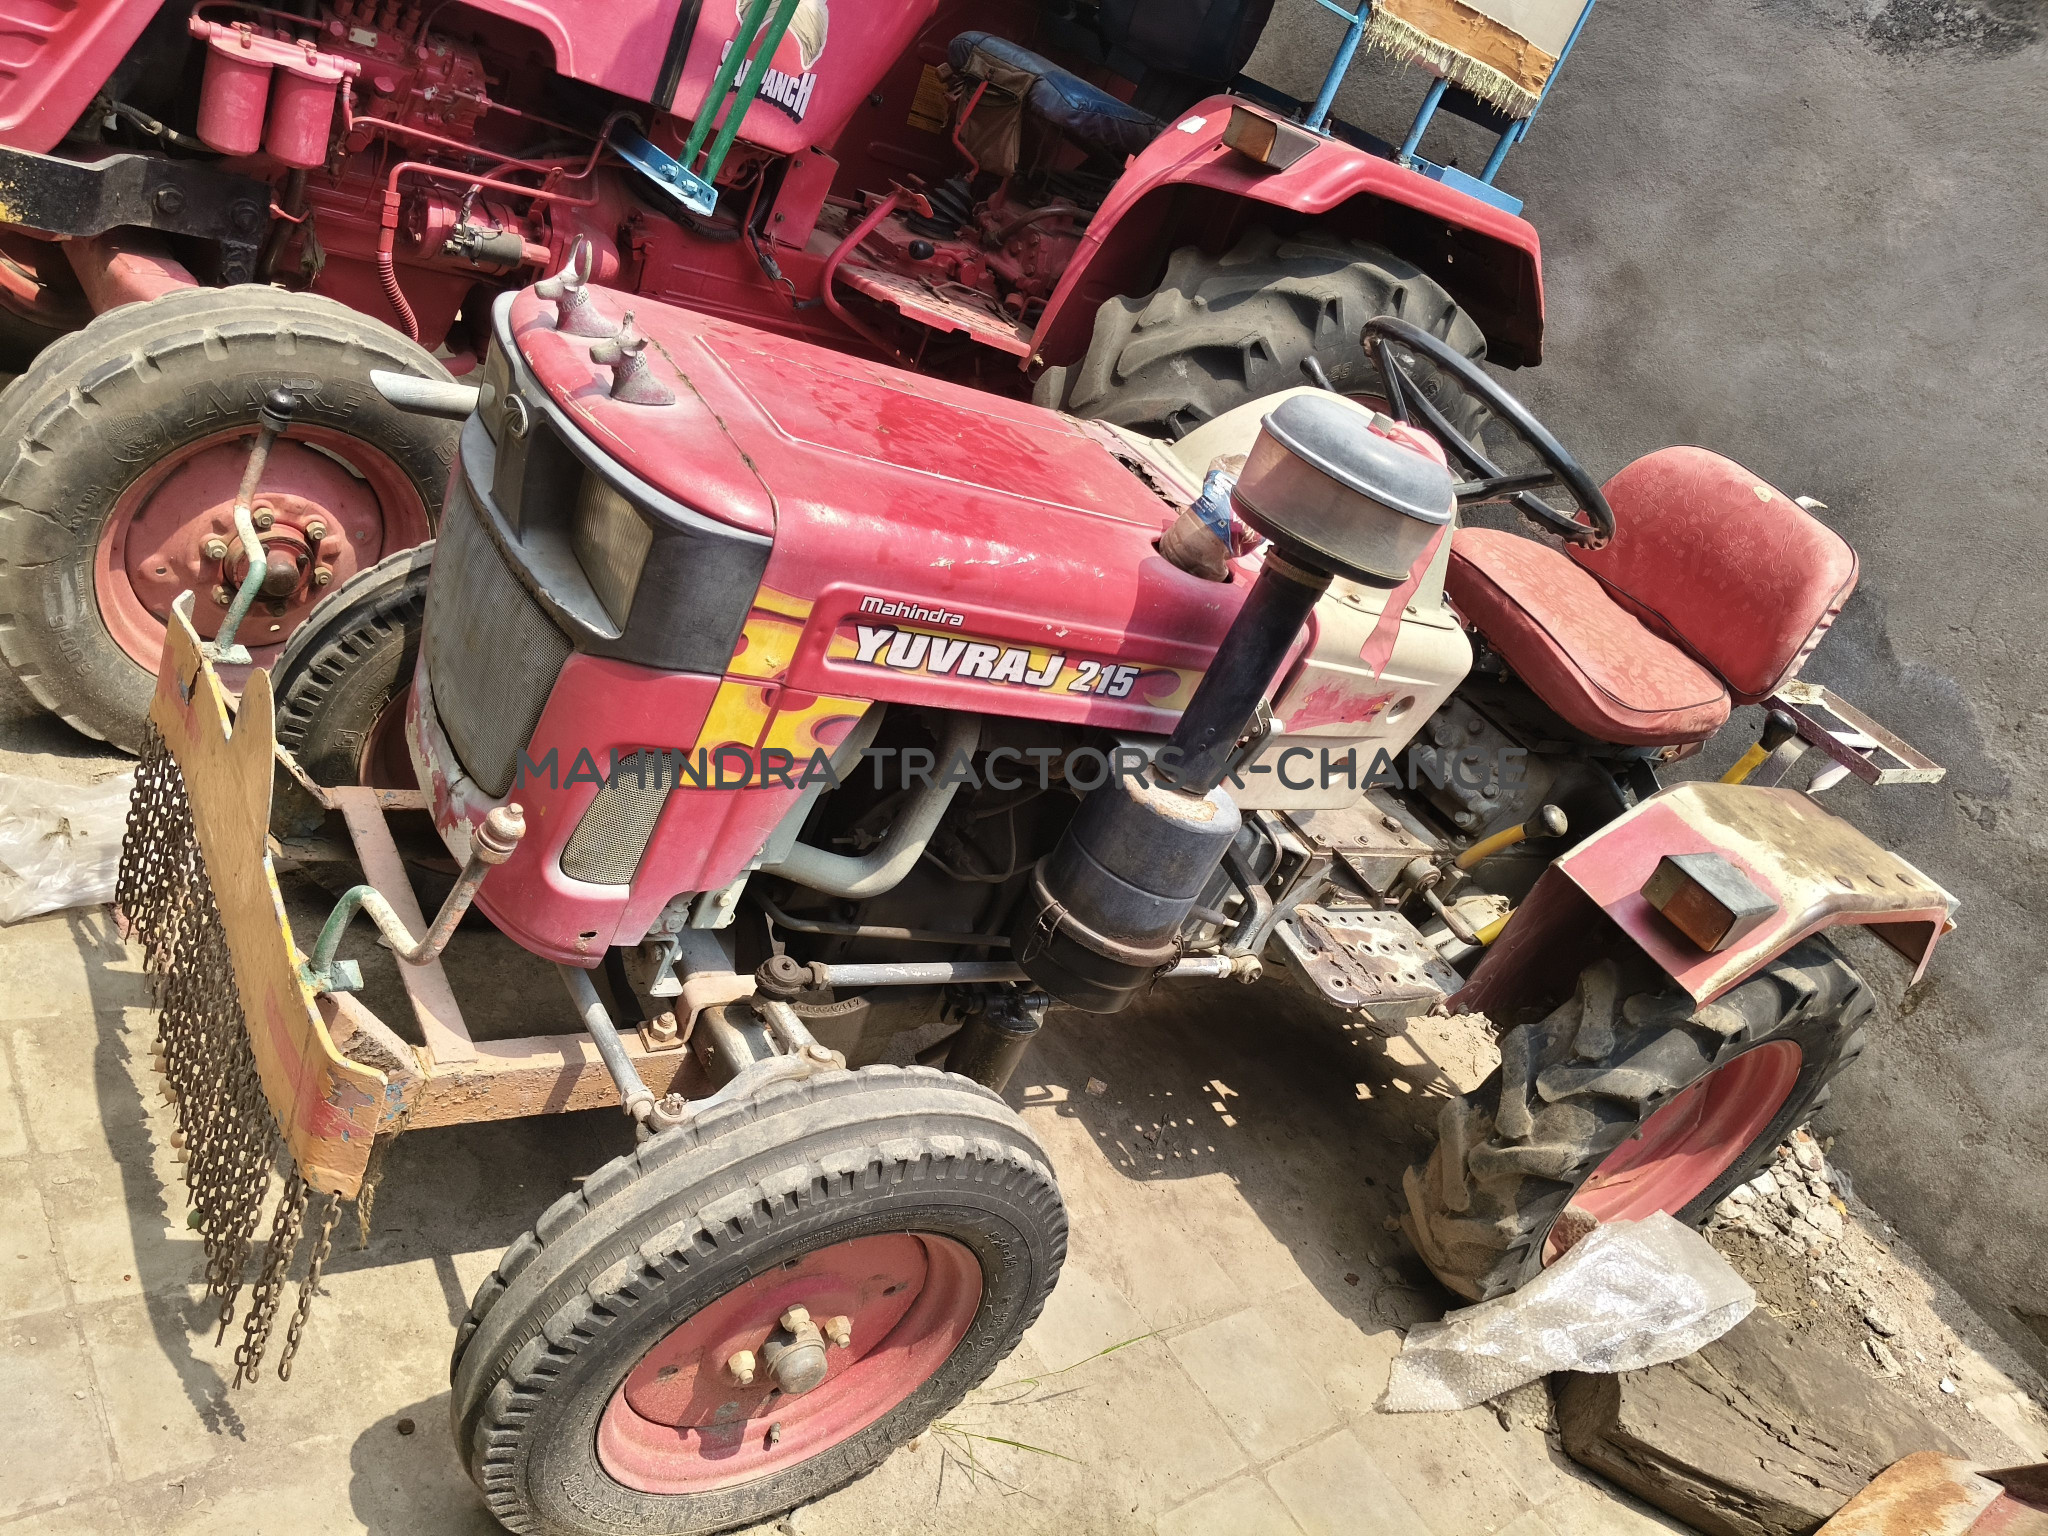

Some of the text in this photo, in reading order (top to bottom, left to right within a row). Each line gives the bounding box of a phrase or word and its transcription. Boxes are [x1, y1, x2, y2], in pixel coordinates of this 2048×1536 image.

[859, 595, 964, 627] Mahindra
[853, 625, 1141, 698] YUVRAJ 215
